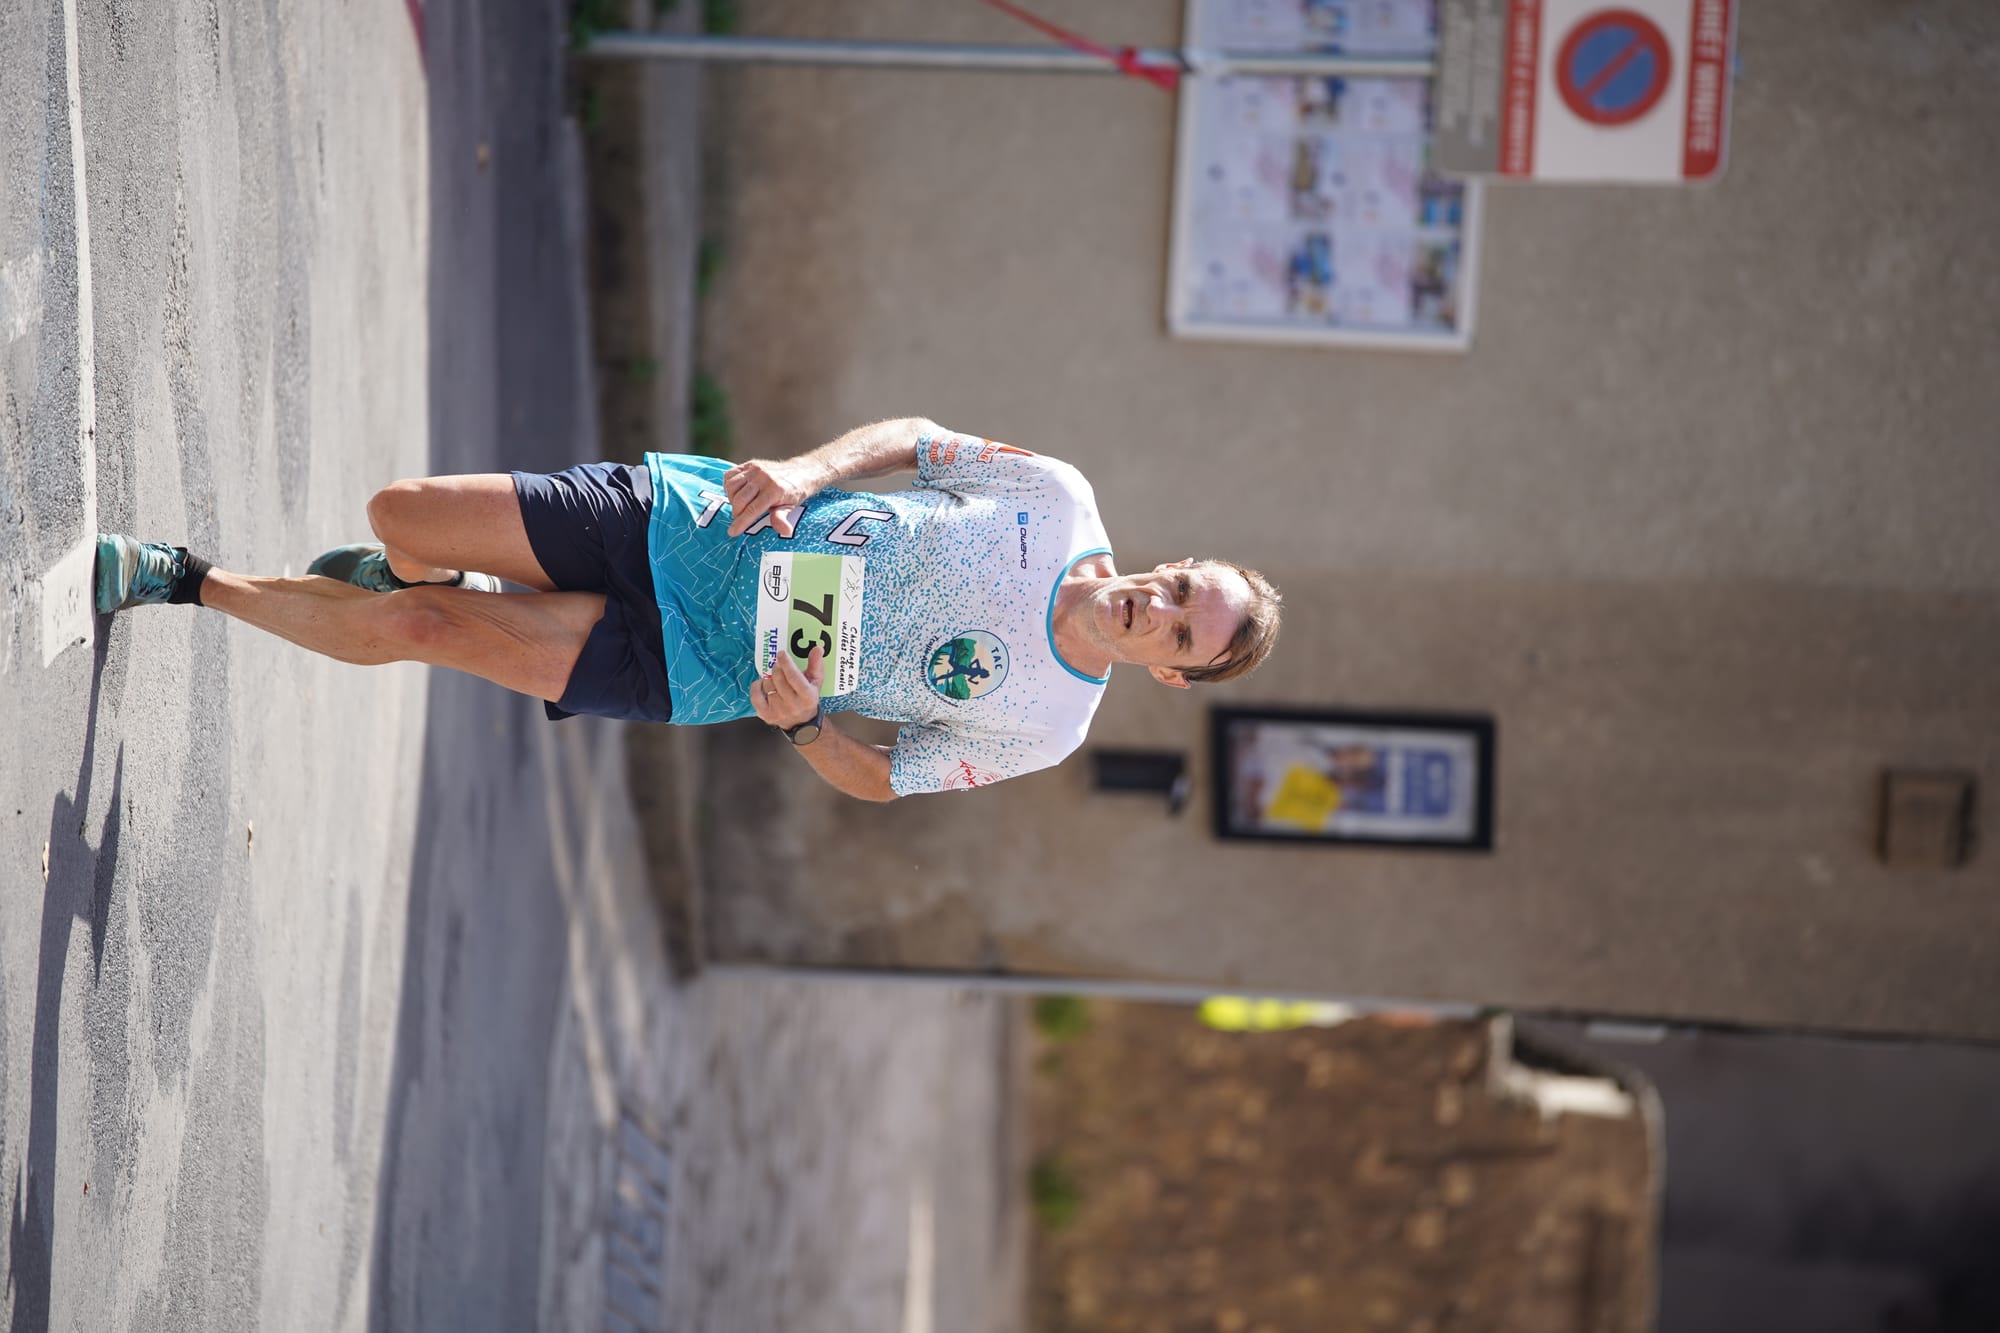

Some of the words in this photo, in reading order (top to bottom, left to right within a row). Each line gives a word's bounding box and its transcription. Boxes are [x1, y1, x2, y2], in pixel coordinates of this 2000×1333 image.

[1696, 0, 1725, 58] RRÊT
[772, 566, 781, 596] BFP
[790, 594, 834, 659] 73
[762, 632, 771, 673] Aventure
[768, 628, 778, 669] TUFF'S
[848, 626, 858, 669] Challenge
[992, 647, 1002, 670] TAC
